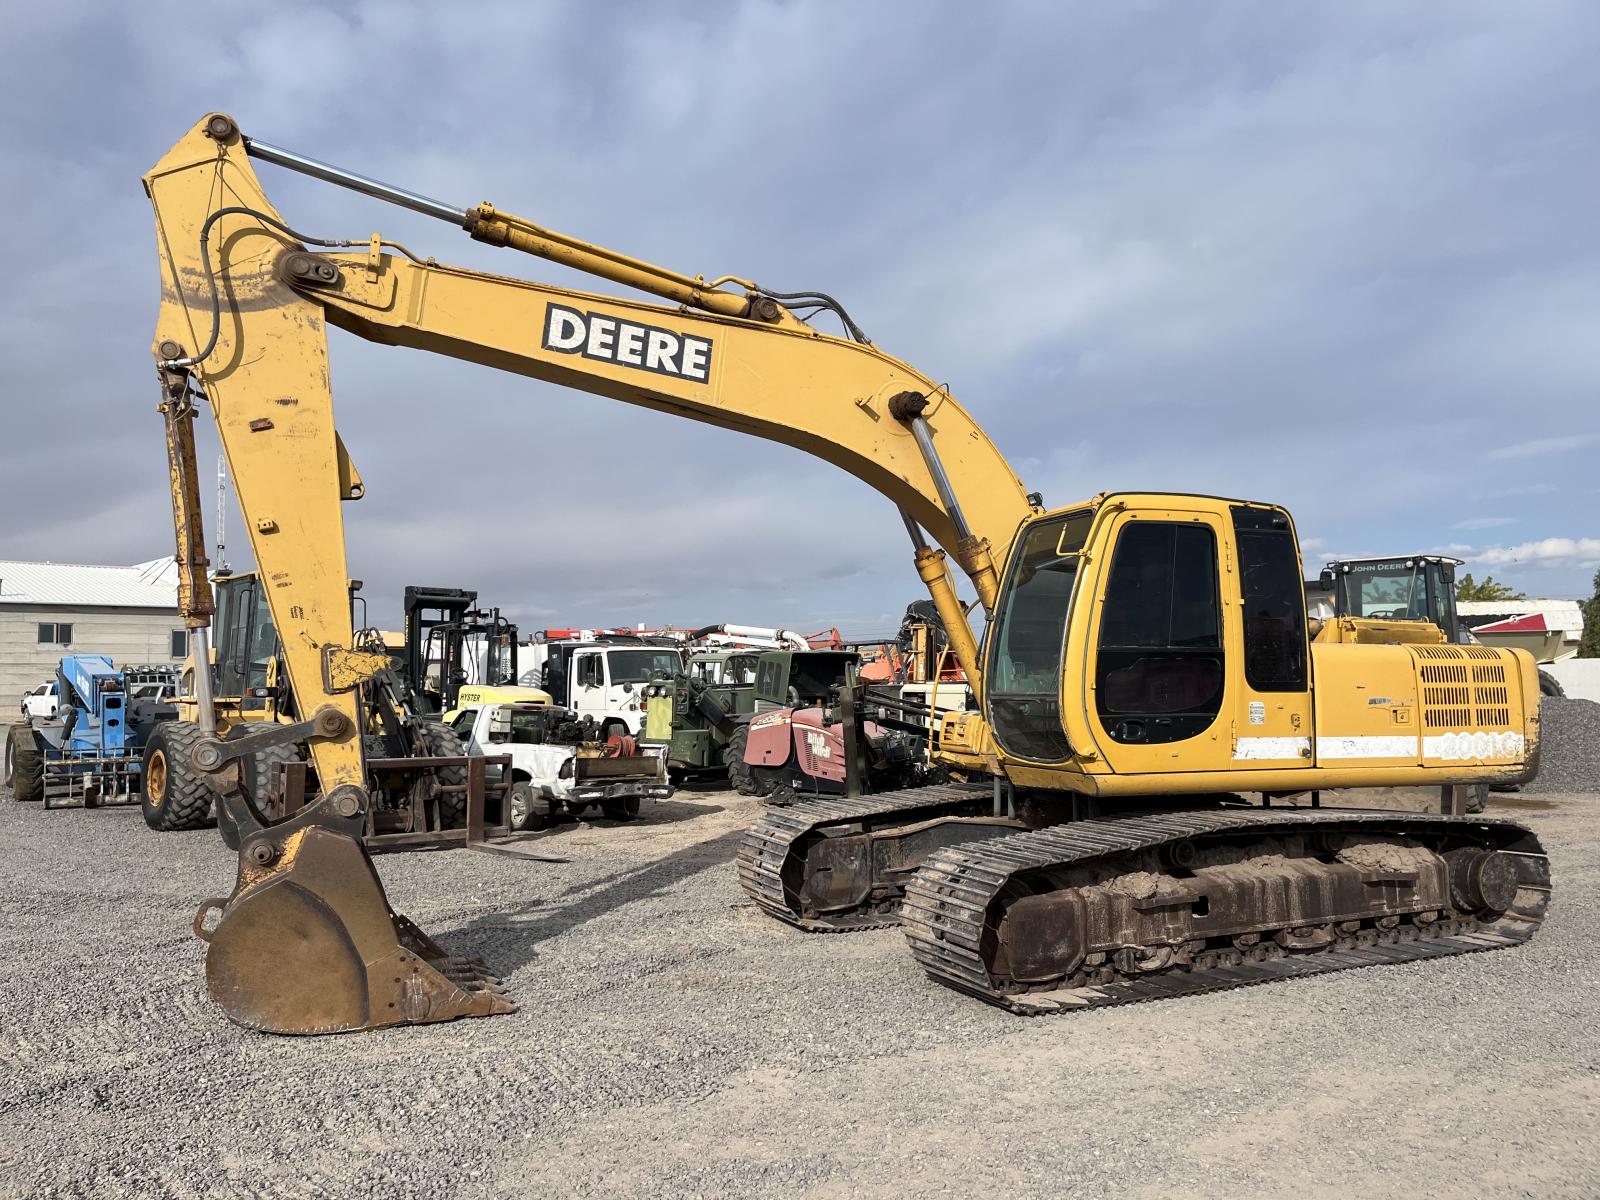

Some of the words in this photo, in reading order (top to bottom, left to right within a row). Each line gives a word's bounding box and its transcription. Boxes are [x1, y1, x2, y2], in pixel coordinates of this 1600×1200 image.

[548, 308, 708, 379] DEERE
[1352, 565, 1375, 573] JOHN
[460, 694, 480, 702] HYSTER
